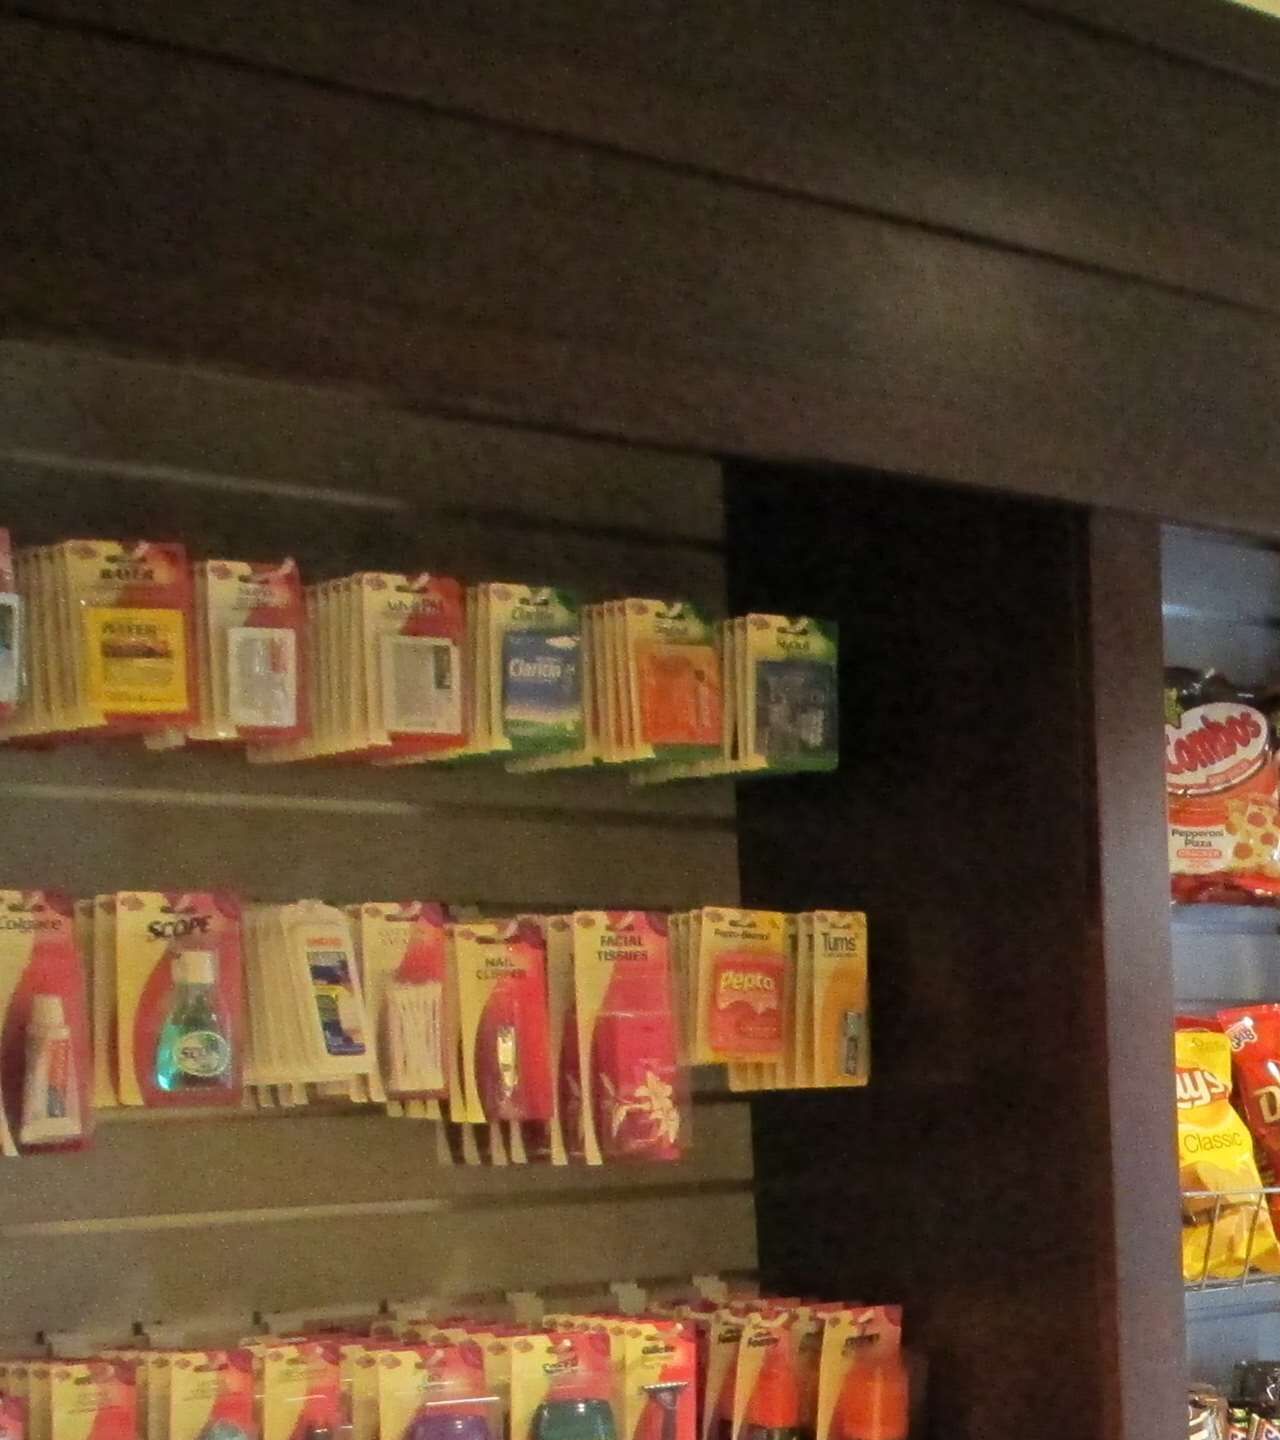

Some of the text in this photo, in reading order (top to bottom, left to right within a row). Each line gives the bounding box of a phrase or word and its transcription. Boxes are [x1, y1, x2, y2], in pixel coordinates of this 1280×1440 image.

[1171, 828, 1225, 842] Pepperoni
[1183, 839, 1213, 849] Pizza
[146, 912, 212, 938] SCOPE
[600, 935, 645, 947] FACIAL
[821, 932, 858, 953] Tums
[596, 948, 649, 961] TISSUES
[484, 956, 516, 968] NAIL
[1183, 1131, 1244, 1154] Classic
